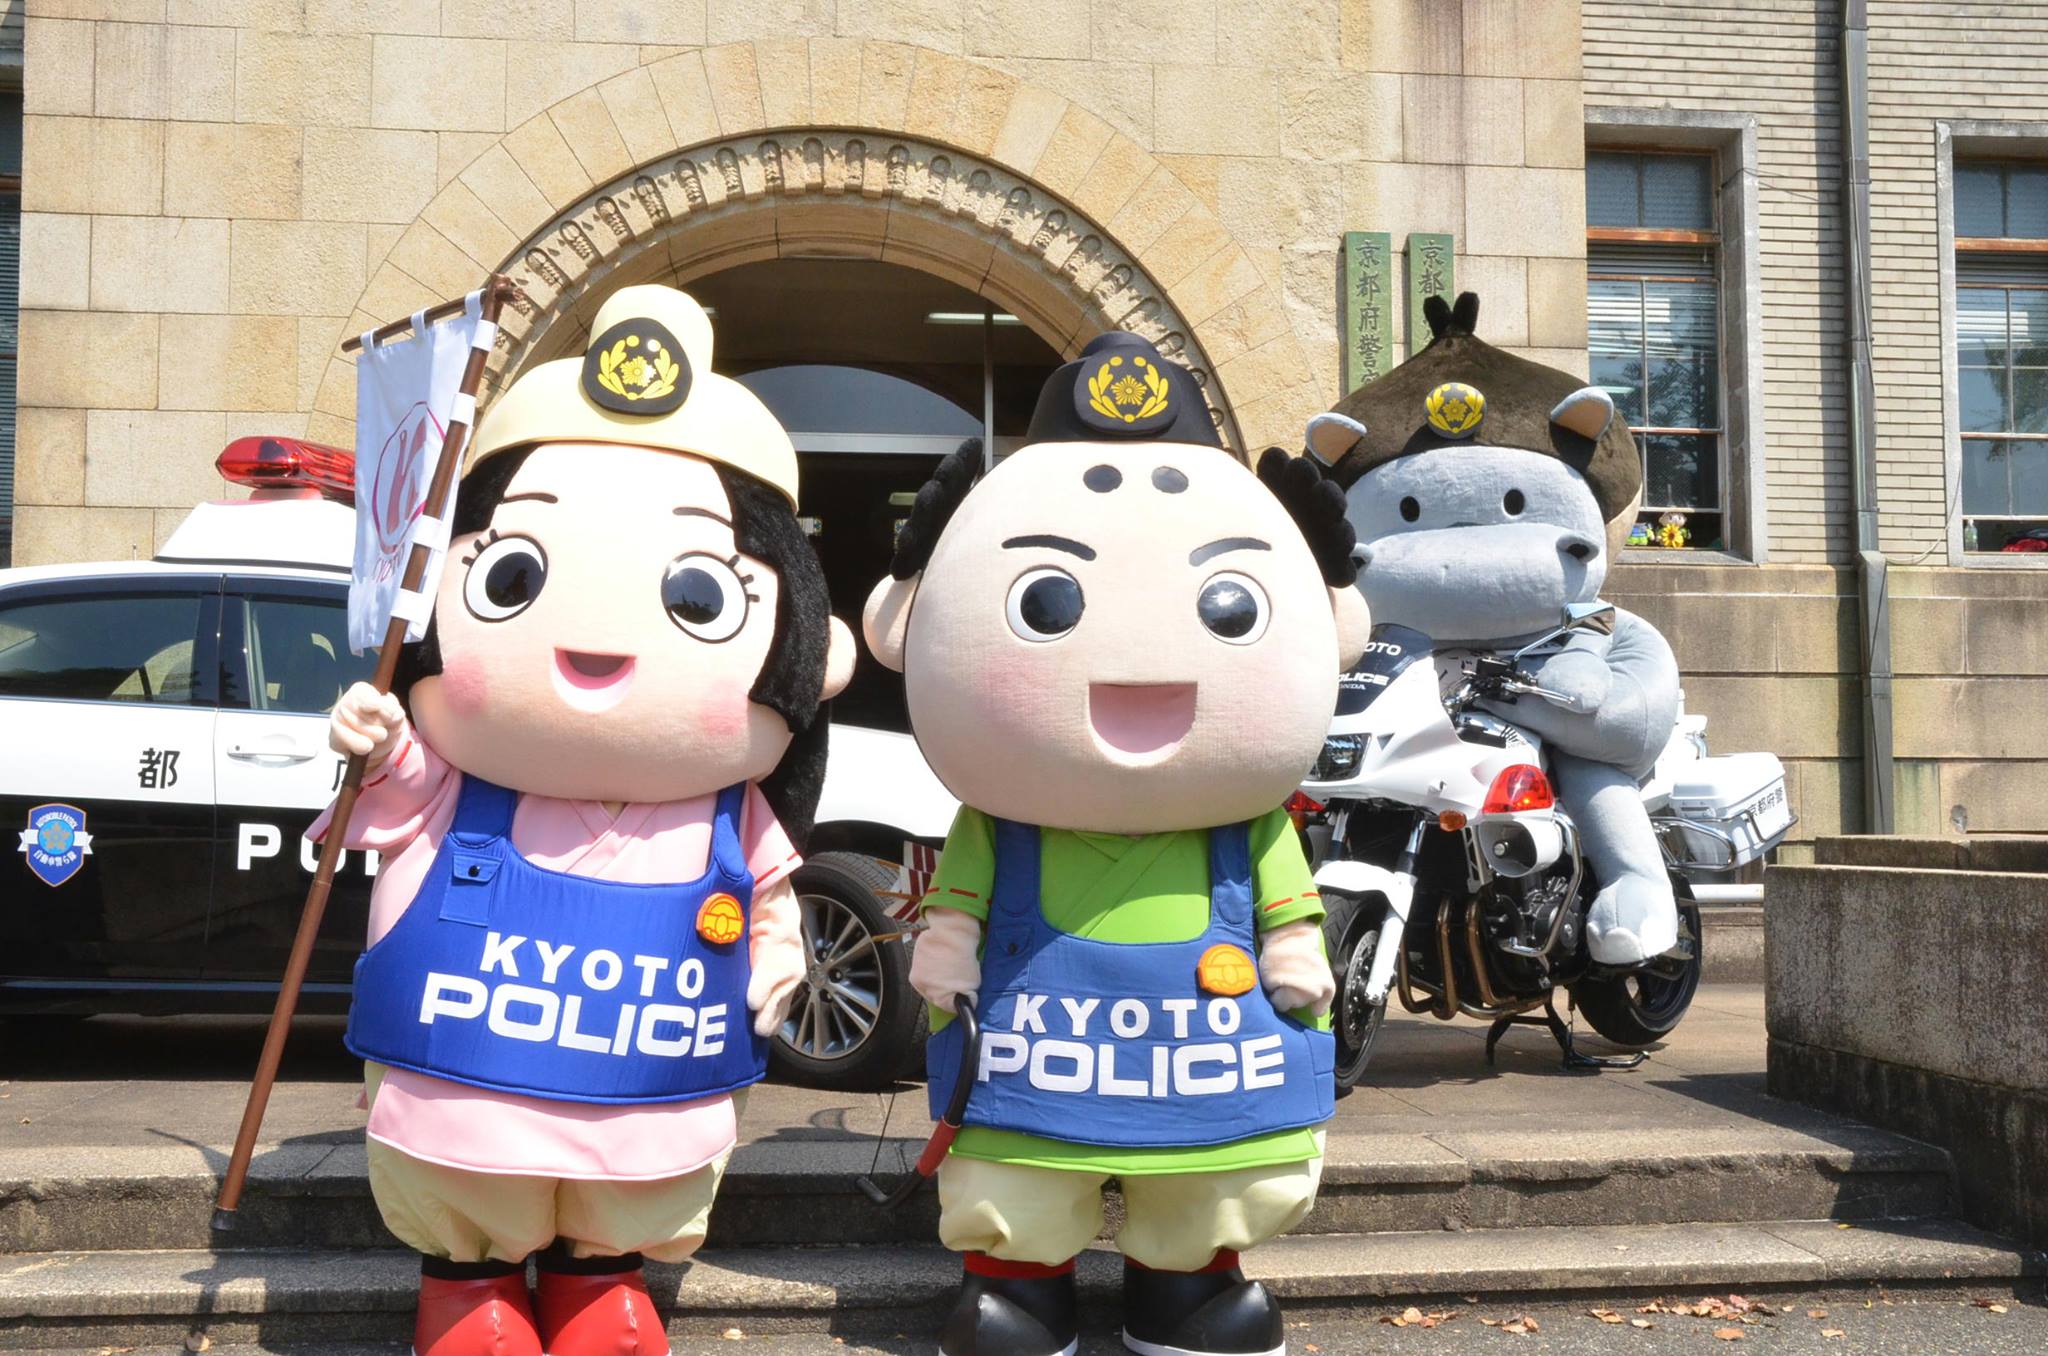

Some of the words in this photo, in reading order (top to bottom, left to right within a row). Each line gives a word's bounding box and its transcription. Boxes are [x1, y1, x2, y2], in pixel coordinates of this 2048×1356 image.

[479, 931, 705, 999] KYOTO
[419, 972, 727, 1059] POLICE
[1011, 993, 1241, 1039] KYOTO
[977, 1032, 1285, 1098] POLICE
